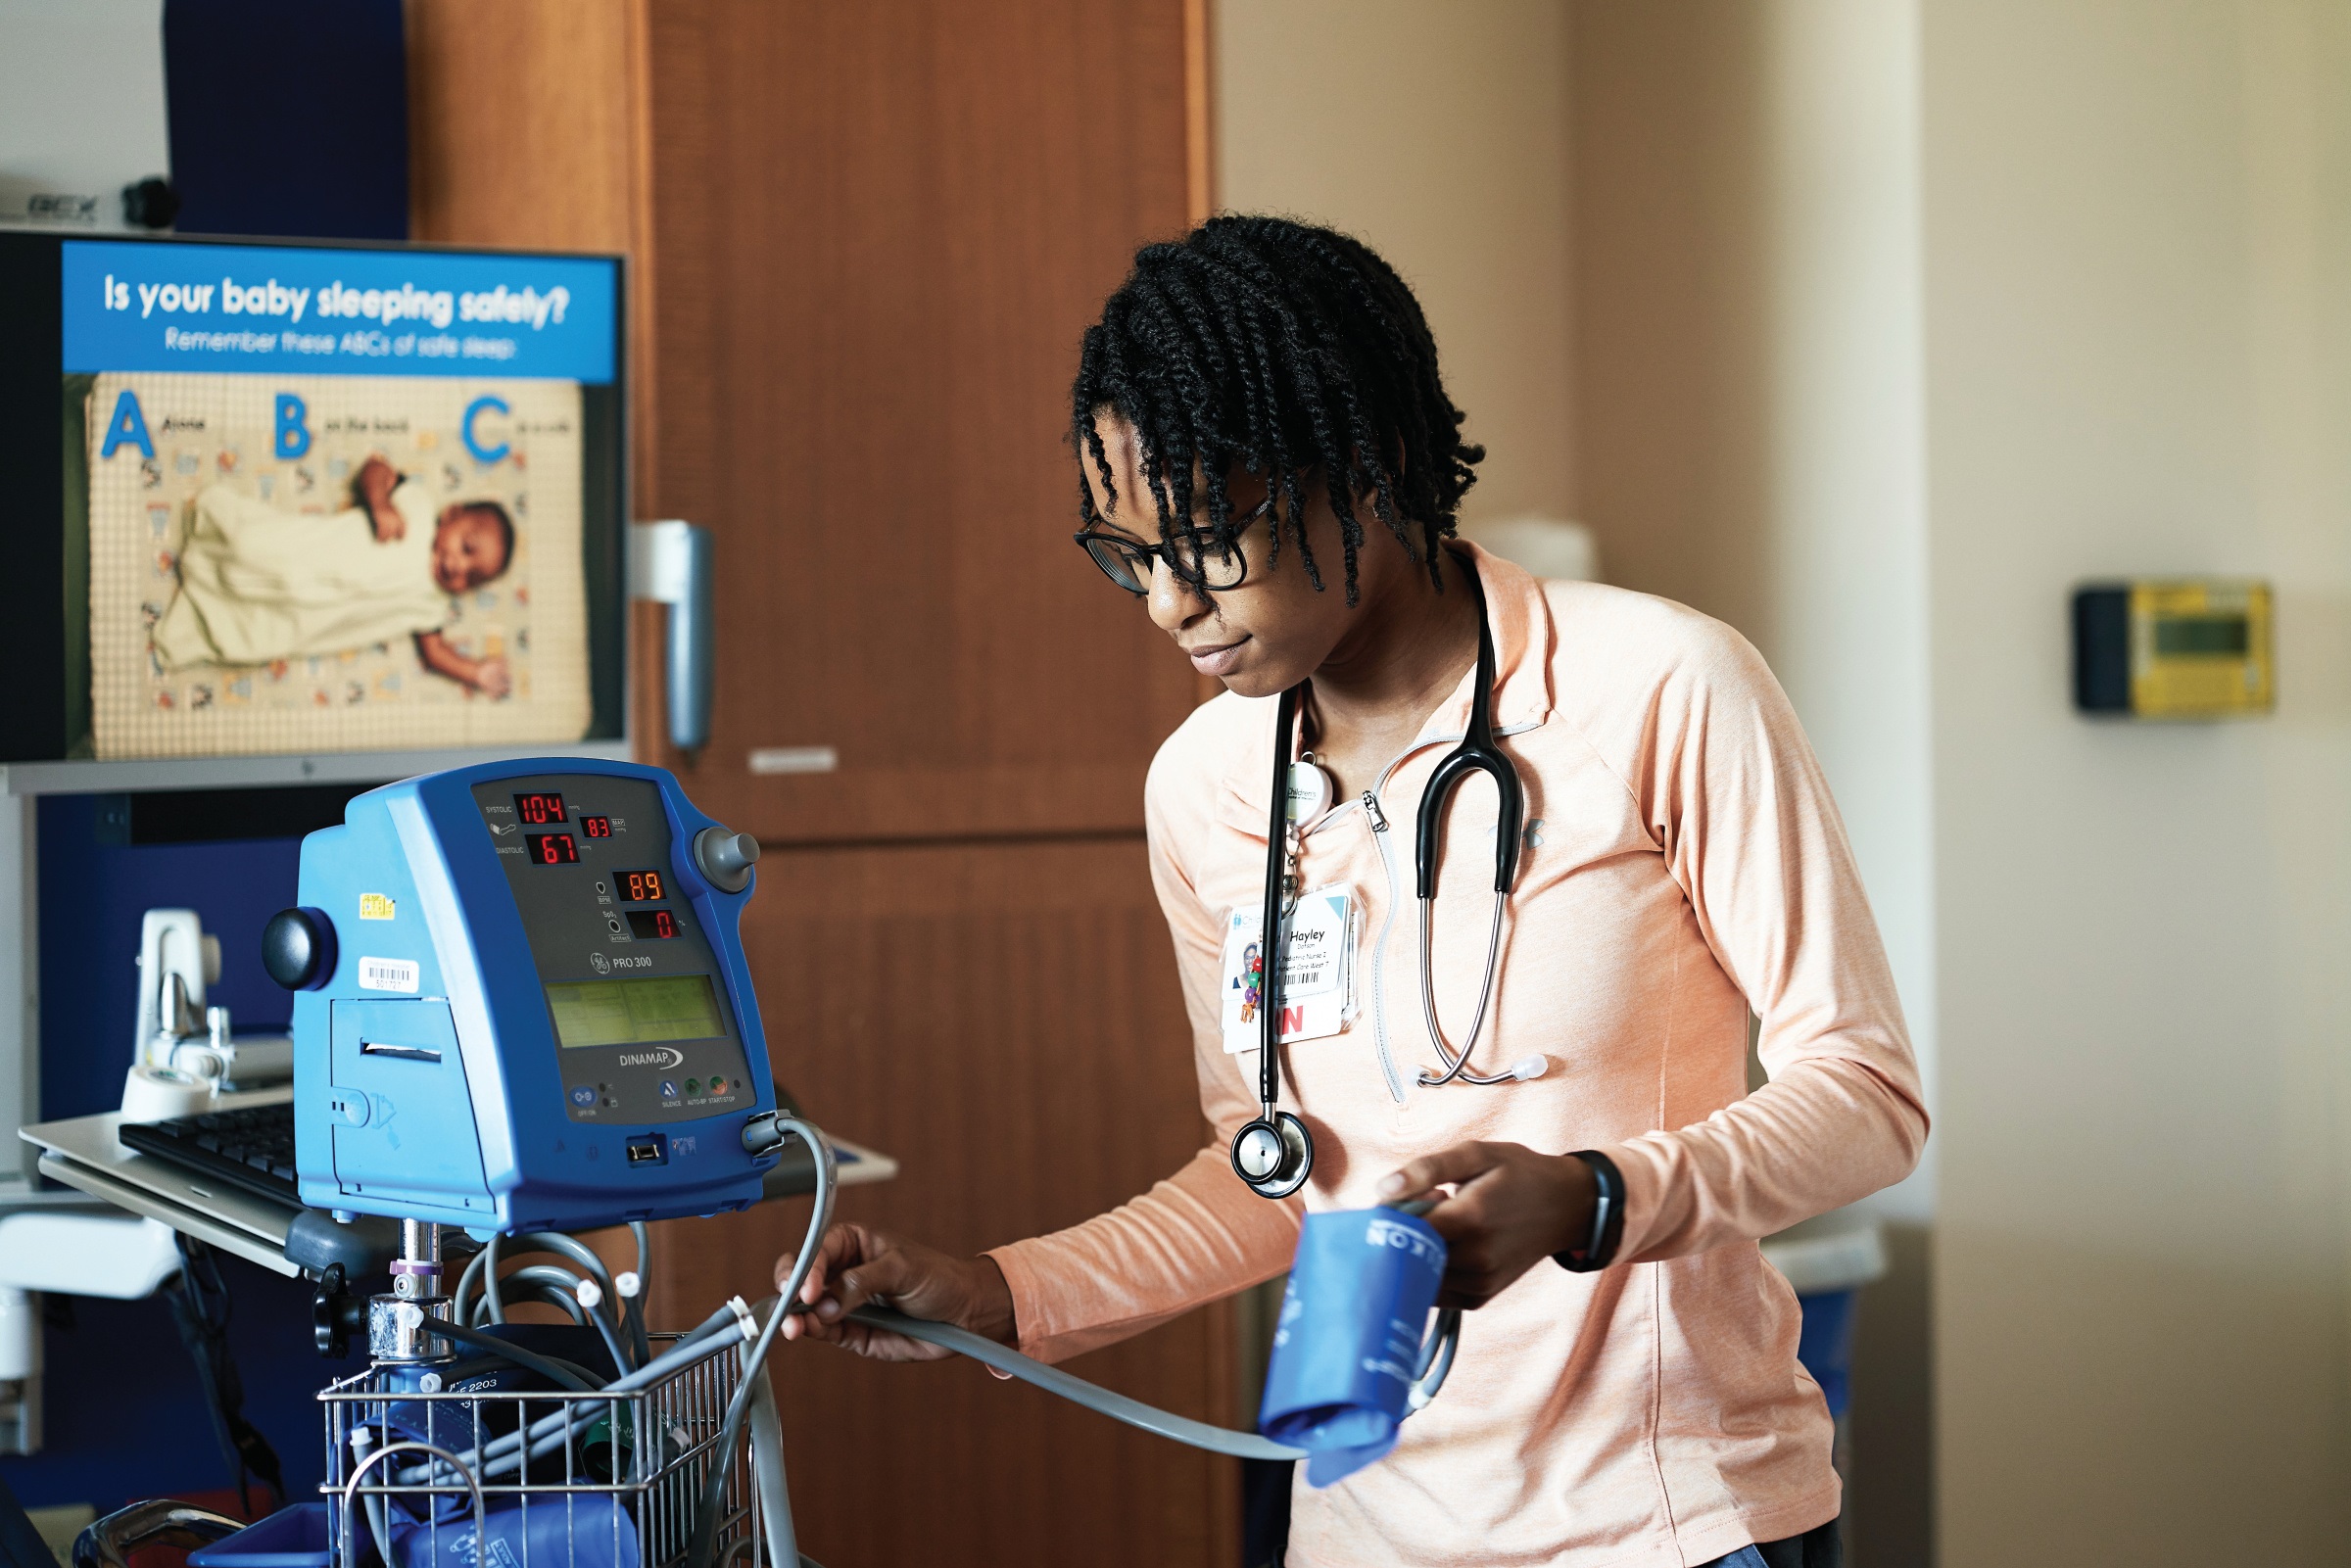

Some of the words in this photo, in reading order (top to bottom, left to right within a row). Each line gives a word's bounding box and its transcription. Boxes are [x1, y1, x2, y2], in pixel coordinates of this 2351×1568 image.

[105, 274, 129, 310] Is
[138, 283, 215, 318] your
[222, 277, 310, 323] baby
[317, 280, 454, 329] sleeping
[459, 284, 570, 331] safely?
[165, 326, 276, 353] Remember
[281, 330, 336, 355] these
[340, 330, 390, 356] ABCs
[394, 332, 416, 357] of
[418, 334, 458, 358] safe
[101, 389, 154, 458] A
[275, 394, 311, 459] B
[461, 394, 509, 463] C
[522, 796, 562, 823] 104
[588, 819, 609, 837] 83
[542, 835, 574, 864] 67
[629, 873, 660, 900] 89
[656, 912, 672, 939] 0
[1290, 928, 1325, 943] Hayley
[612, 958, 634, 969] PRO
[634, 956, 652, 968] 300
[468, 1378, 498, 1393] 2203
